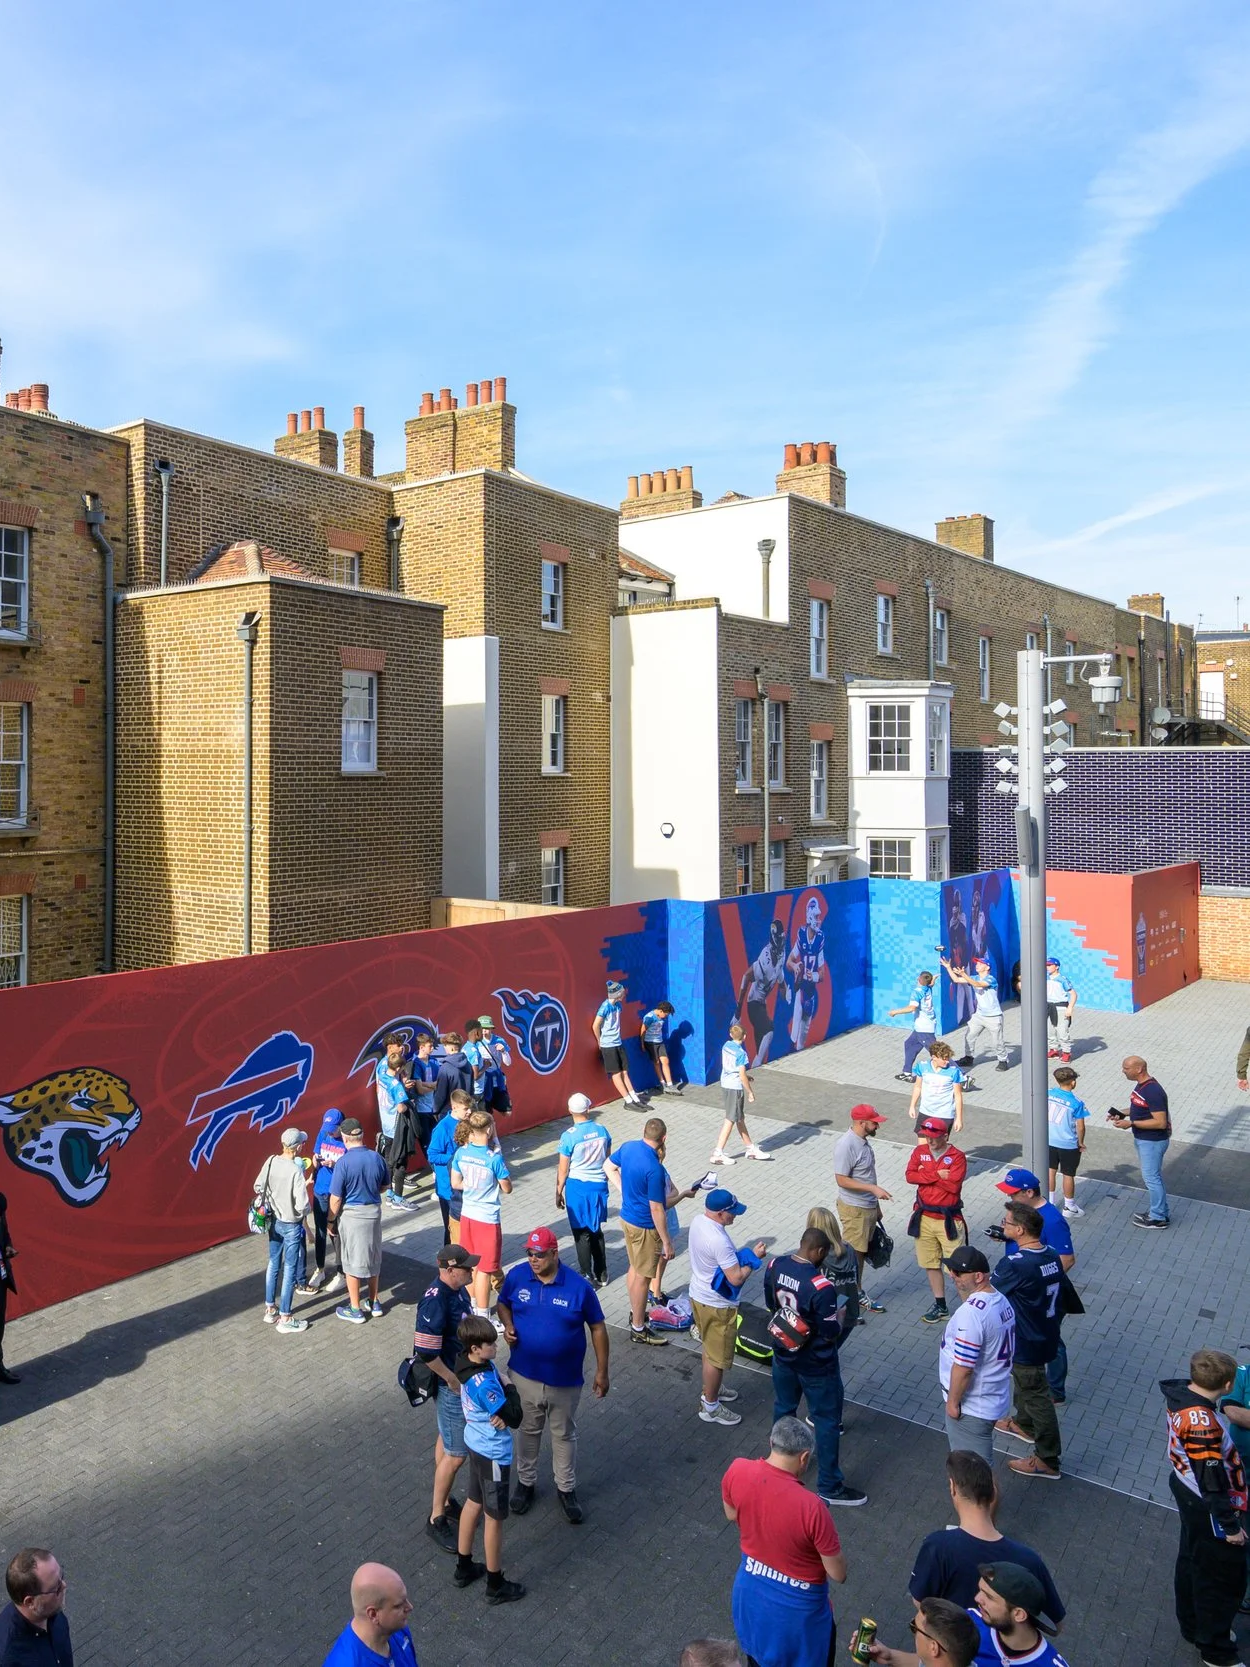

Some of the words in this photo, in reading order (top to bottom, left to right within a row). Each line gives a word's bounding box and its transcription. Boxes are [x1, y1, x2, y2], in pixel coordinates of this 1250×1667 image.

[1039, 1261, 1059, 1277] DIGGS
[777, 1273, 800, 1292] JUDON
[424, 1287, 439, 1297] 24
[1046, 1282, 1060, 1318] 7
[552, 1297, 568, 1308] COACH
[1188, 1409, 1210, 1426] 85
